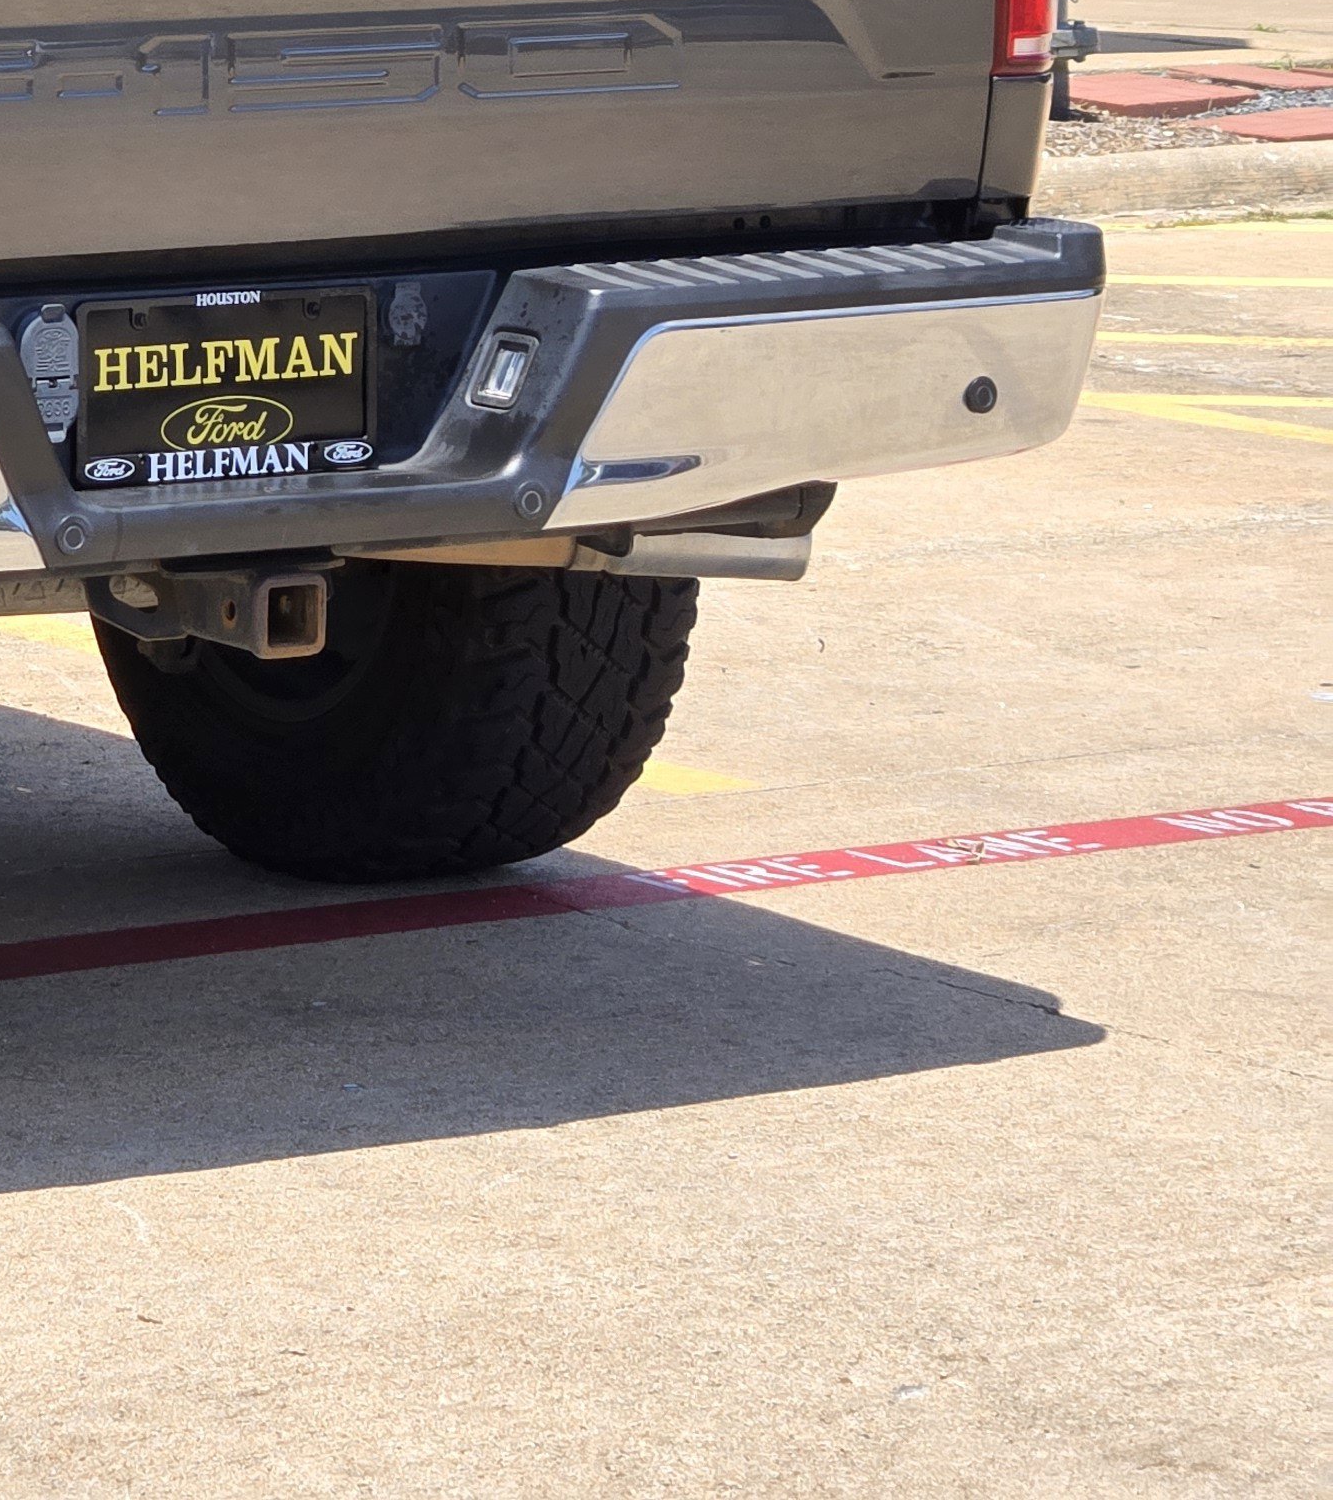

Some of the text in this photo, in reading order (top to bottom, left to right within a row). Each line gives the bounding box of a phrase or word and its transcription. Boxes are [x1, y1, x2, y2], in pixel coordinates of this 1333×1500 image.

[196, 290, 262, 307] HOUSTON
[94, 332, 358, 391] HELFMAN
[186, 404, 268, 446] Ford
[147, 442, 312, 482] HELFMAN
[332, 443, 365, 460] Ford
[93, 461, 126, 477] Ford
